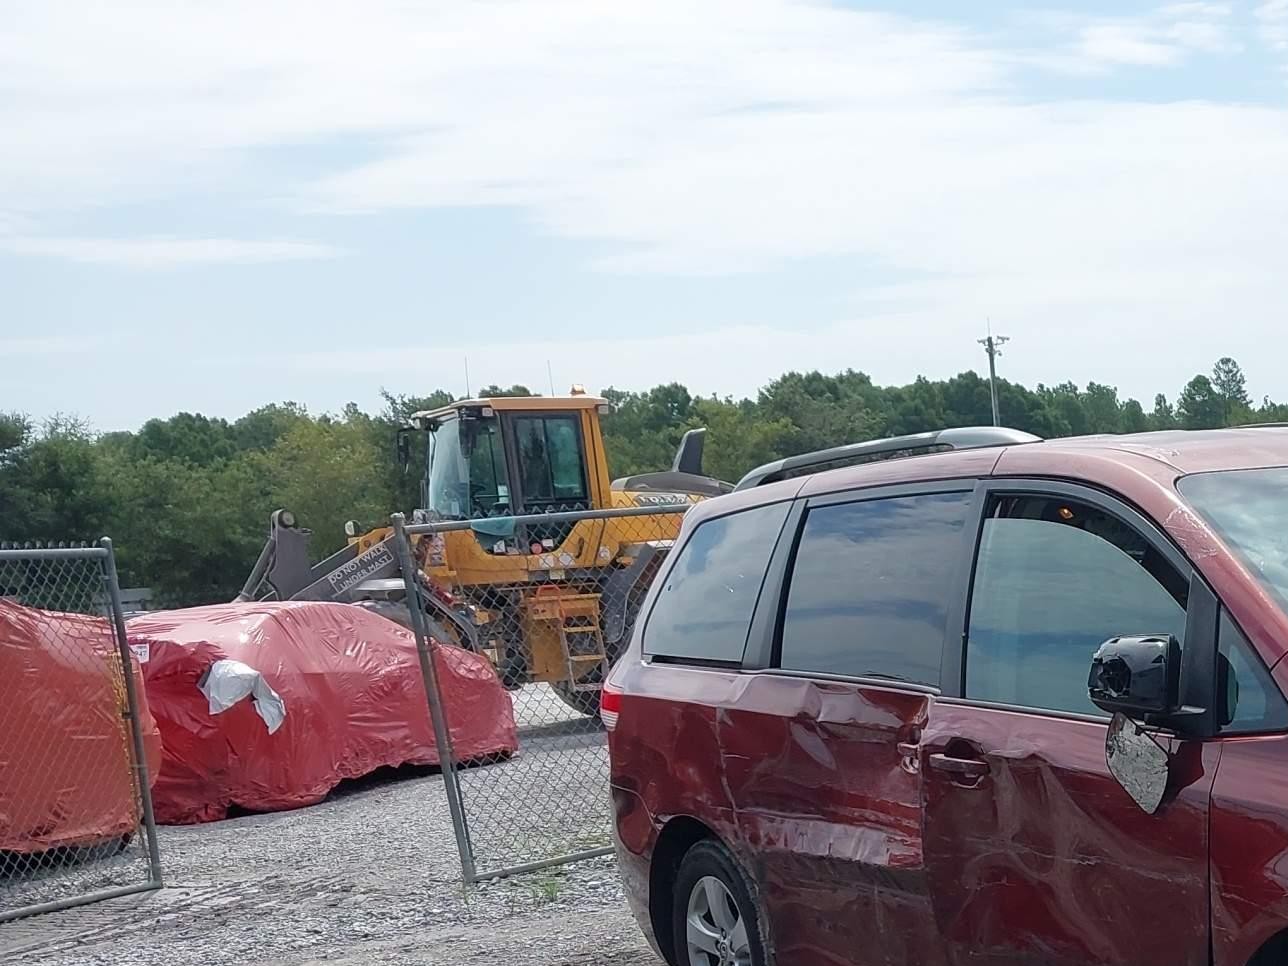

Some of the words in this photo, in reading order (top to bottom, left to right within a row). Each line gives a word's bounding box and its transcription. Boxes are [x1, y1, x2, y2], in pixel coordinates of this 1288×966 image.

[329, 571, 343, 584] DO
[344, 558, 361, 576] NOT
[362, 545, 387, 563] WALK
[340, 569, 368, 588] UNDER
[367, 554, 390, 572] MAST
